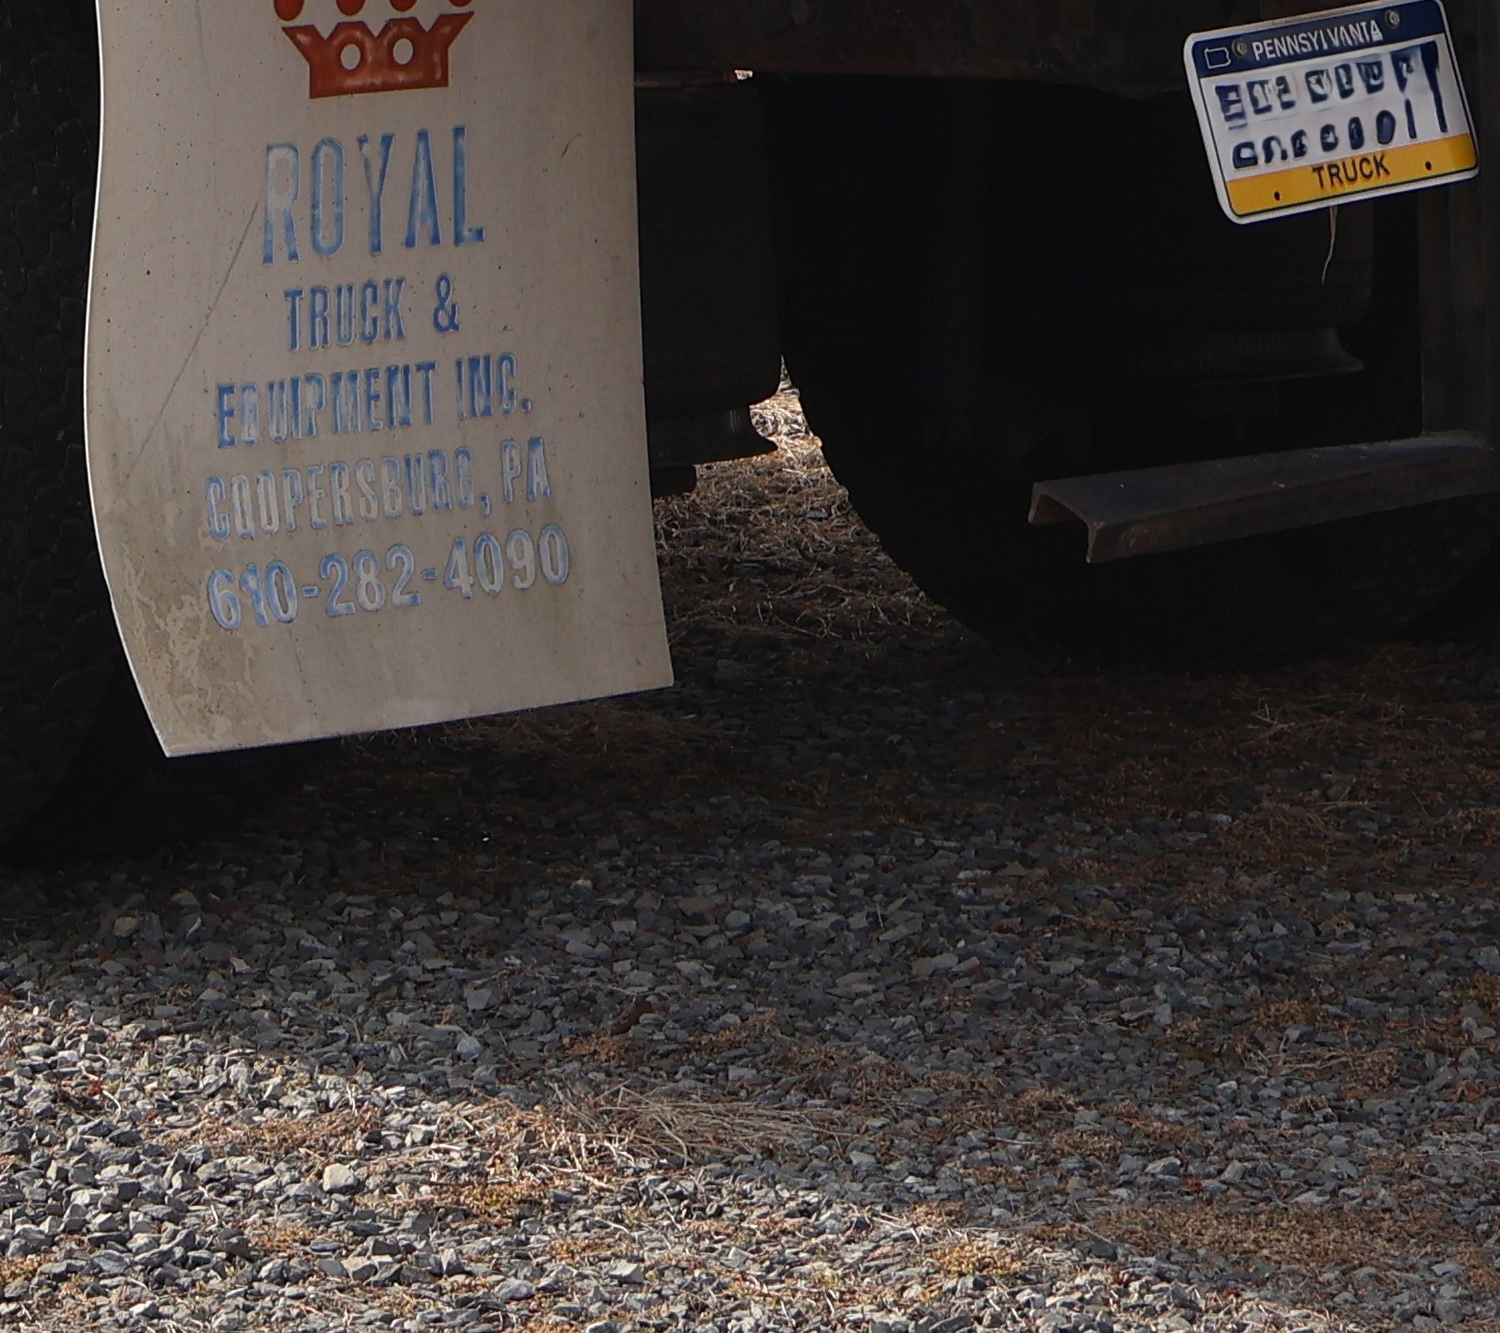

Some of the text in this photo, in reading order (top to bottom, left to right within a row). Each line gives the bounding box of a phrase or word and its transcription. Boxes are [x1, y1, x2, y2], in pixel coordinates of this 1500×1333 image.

[261, 124, 486, 266] ROYAL
[1312, 153, 1391, 190] TRUCK
[283, 272, 461, 352] TRUCK &
[215, 351, 533, 449] EQUIPMENT INC.
[205, 435, 552, 541] COOPERSBURG, PA
[206, 523, 570, 631] 610-282-4090
